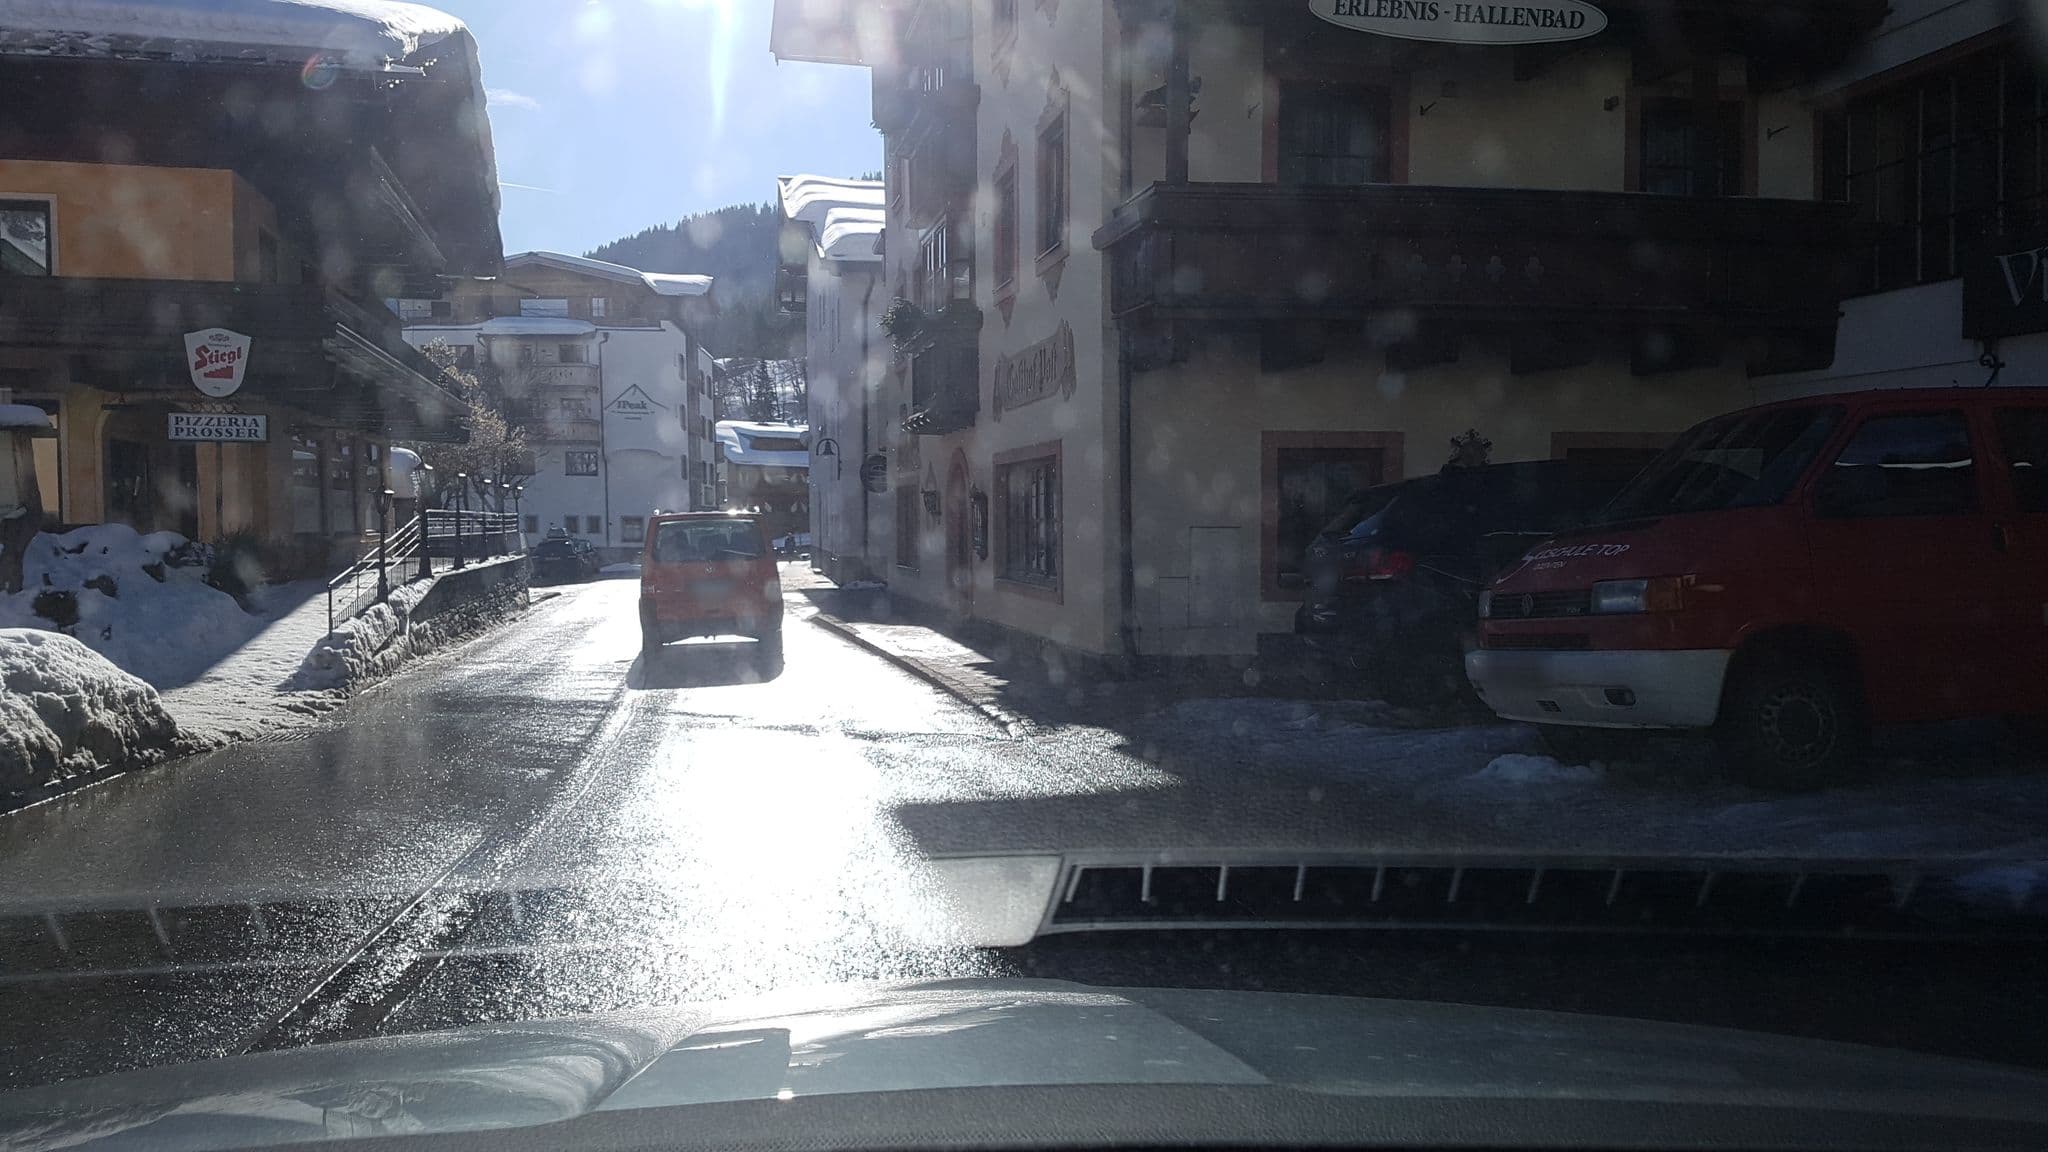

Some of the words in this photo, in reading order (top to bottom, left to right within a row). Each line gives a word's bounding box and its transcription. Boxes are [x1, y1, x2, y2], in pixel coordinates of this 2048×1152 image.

[1333, 0, 1439, 21] ERLEBNIS
[1454, 4, 1585, 30] HALLENBAD
[194, 344, 242, 370] Stiegl
[174, 416, 260, 427] PIZZERIA
[174, 427, 260, 438] PROSSER
[1596, 544, 1631, 557] TOP
